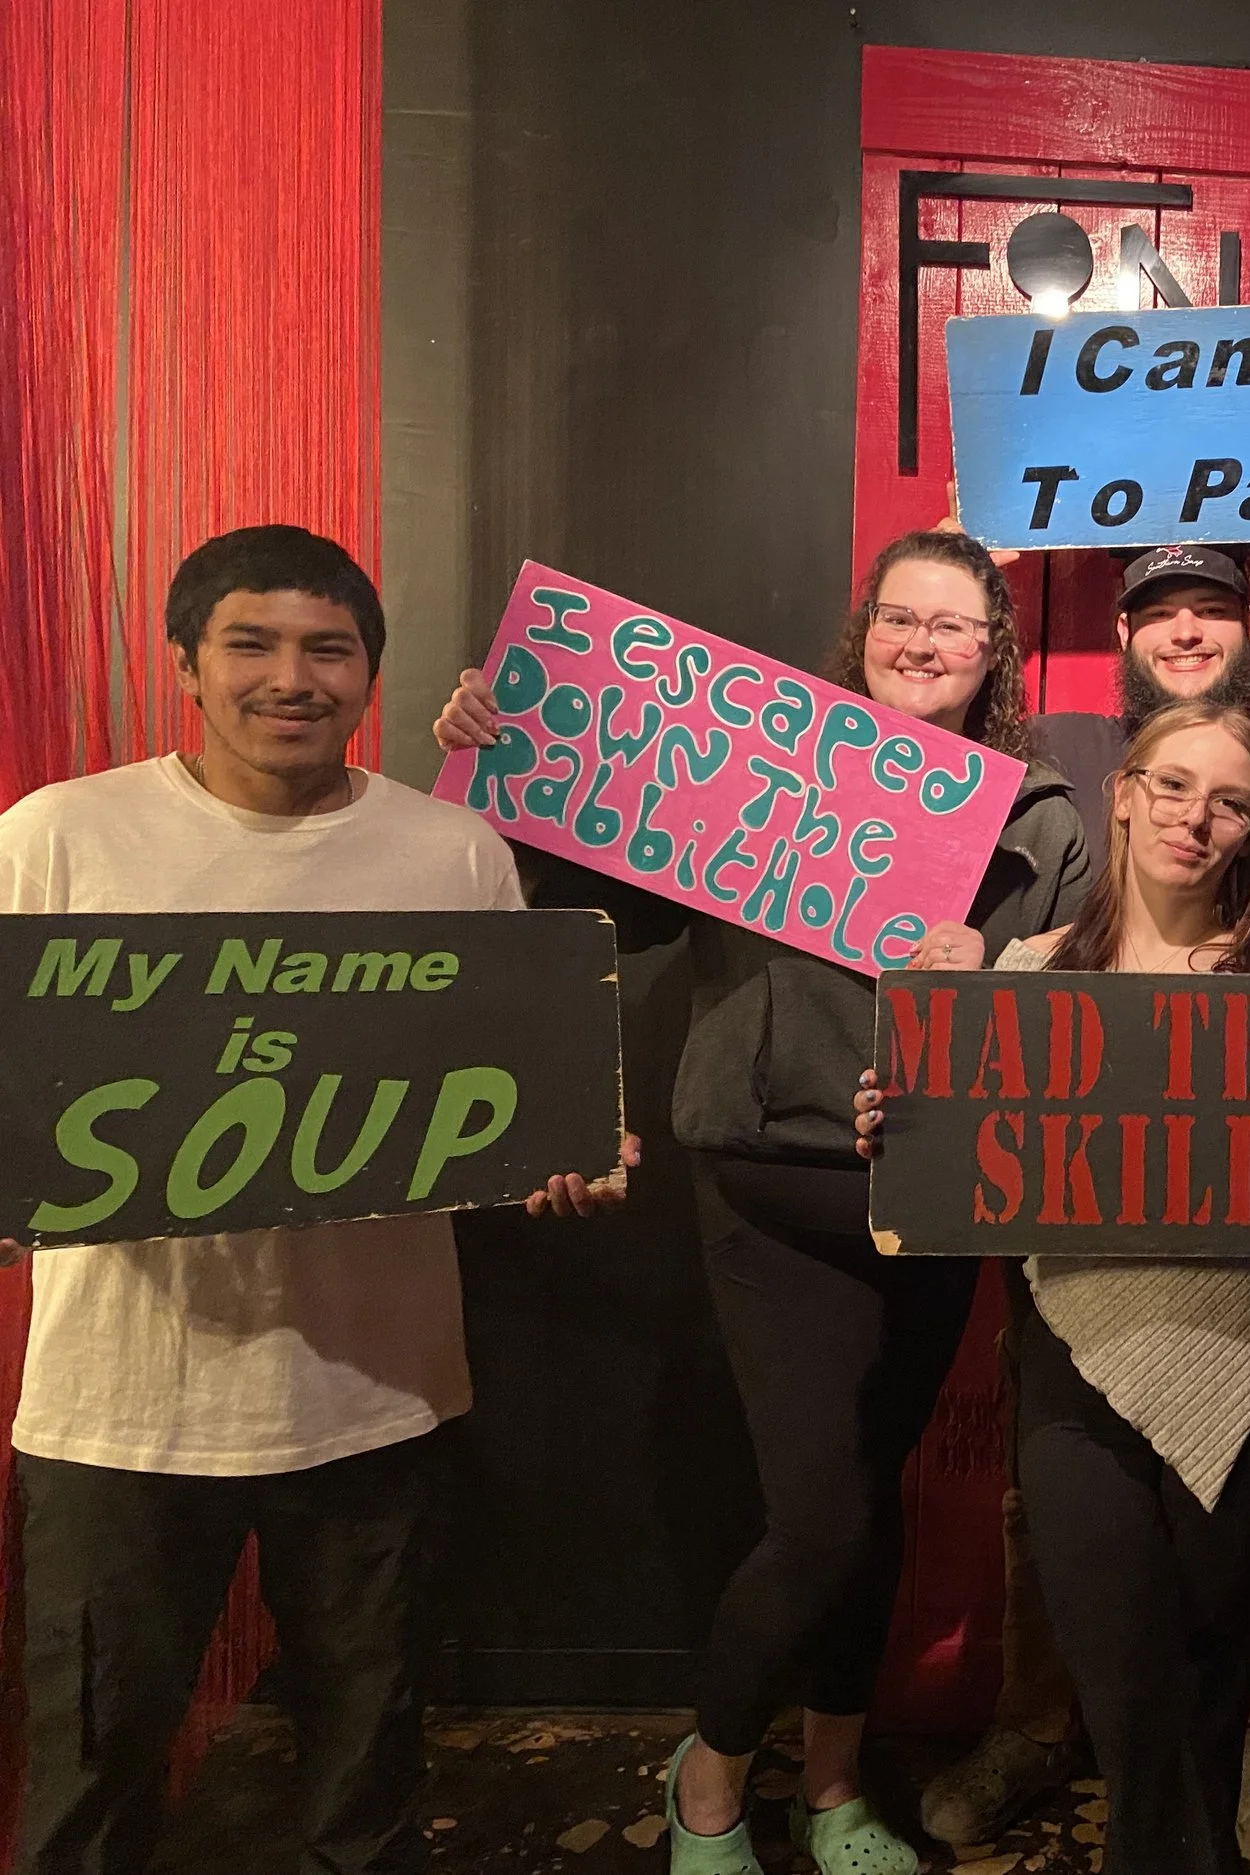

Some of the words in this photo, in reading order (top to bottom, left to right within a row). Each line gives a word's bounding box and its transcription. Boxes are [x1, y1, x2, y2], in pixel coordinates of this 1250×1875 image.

[1020, 329, 1055, 396] I
[1021, 464, 1143, 530] To
[525, 586, 592, 655] I
[610, 615, 984, 816] escaped
[739, 755, 897, 877] The
[27, 938, 183, 1012] My
[204, 938, 460, 995] Name
[216, 1017, 298, 1074] is
[883, 988, 1105, 1099] MAD
[27, 1067, 518, 1233] SOUP
